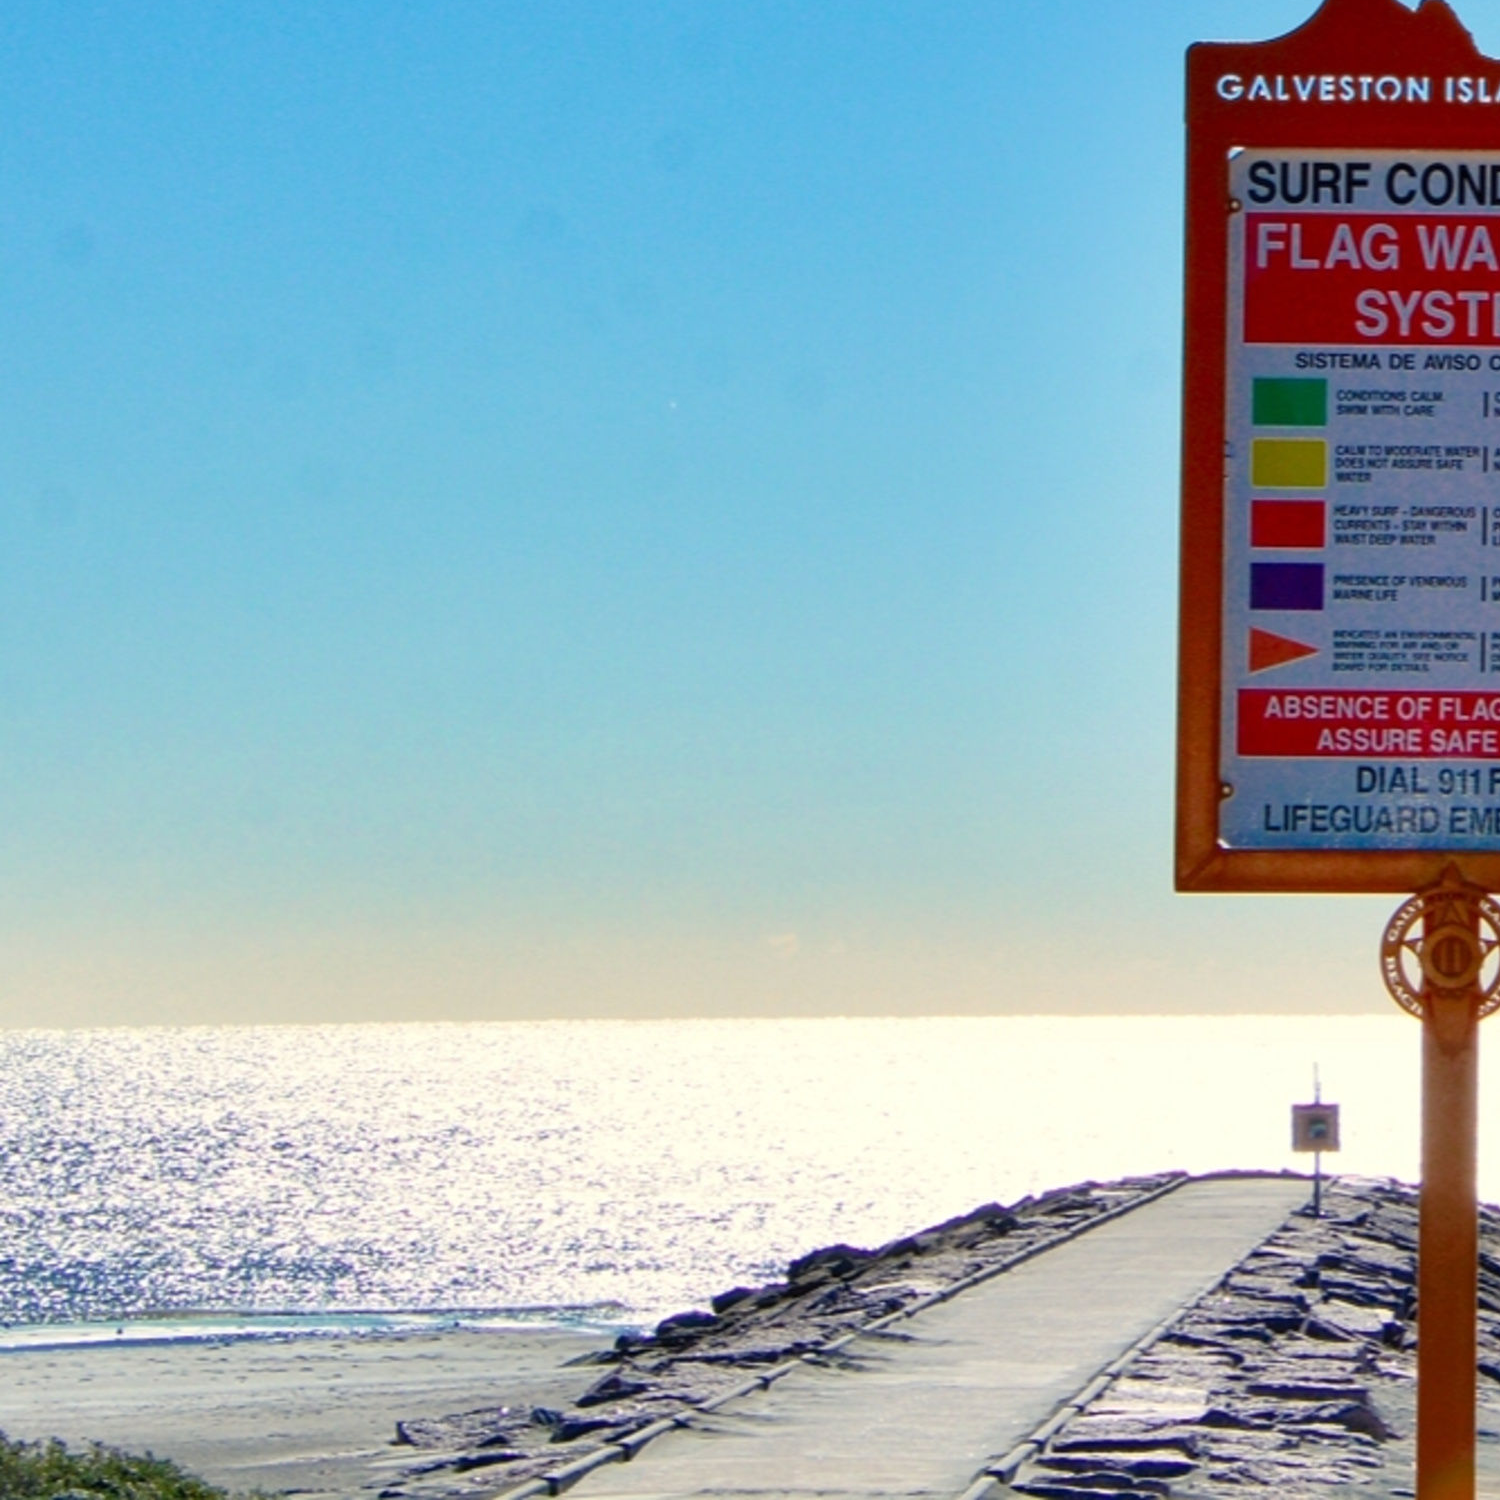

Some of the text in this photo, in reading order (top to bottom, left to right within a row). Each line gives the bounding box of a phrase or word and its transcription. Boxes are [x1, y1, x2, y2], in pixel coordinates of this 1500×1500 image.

[1216, 74, 1430, 102] GALVESTON
[1248, 160, 1371, 205] SURF
[1257, 223, 1400, 270] FLAG
[1295, 352, 1381, 370] SISTEMA
[1389, 353, 1414, 370] DE
[1424, 354, 1481, 371] AVISO
[1336, 390, 1407, 402] CONDITIONS
[1336, 405, 1436, 417] SWIM WITH CARE
[1335, 446, 1481, 458] CALM TO MODERATE WATER
[1335, 458, 1464, 470] DOES NOT ASSURE SAFE
[1335, 472, 1372, 482] WATER
[1333, 506, 1369, 516] HEAVY
[1371, 506, 1399, 517] SURF
[1410, 506, 1477, 518] DANGEROUS
[1333, 520, 1391, 531] CURRENTS
[1402, 520, 1427, 531] STAY
[1430, 520, 1468, 532] WITHIN
[1334, 534, 1437, 546] WAIST DEEP WATER
[1333, 575, 1389, 586] PRESENCE
[1391, 576, 1407, 586] OF
[1333, 589, 1398, 601] MARINE LIFE
[1264, 695, 1390, 719] ABSENCE
[1396, 696, 1433, 721] OF
[1316, 728, 1423, 752] ASSURE
[1429, 729, 1499, 753] SAFE
[1356, 766, 1430, 794] DIAL
[1438, 768, 1481, 795] 911
[1263, 804, 1441, 834] LIFEGUARD
